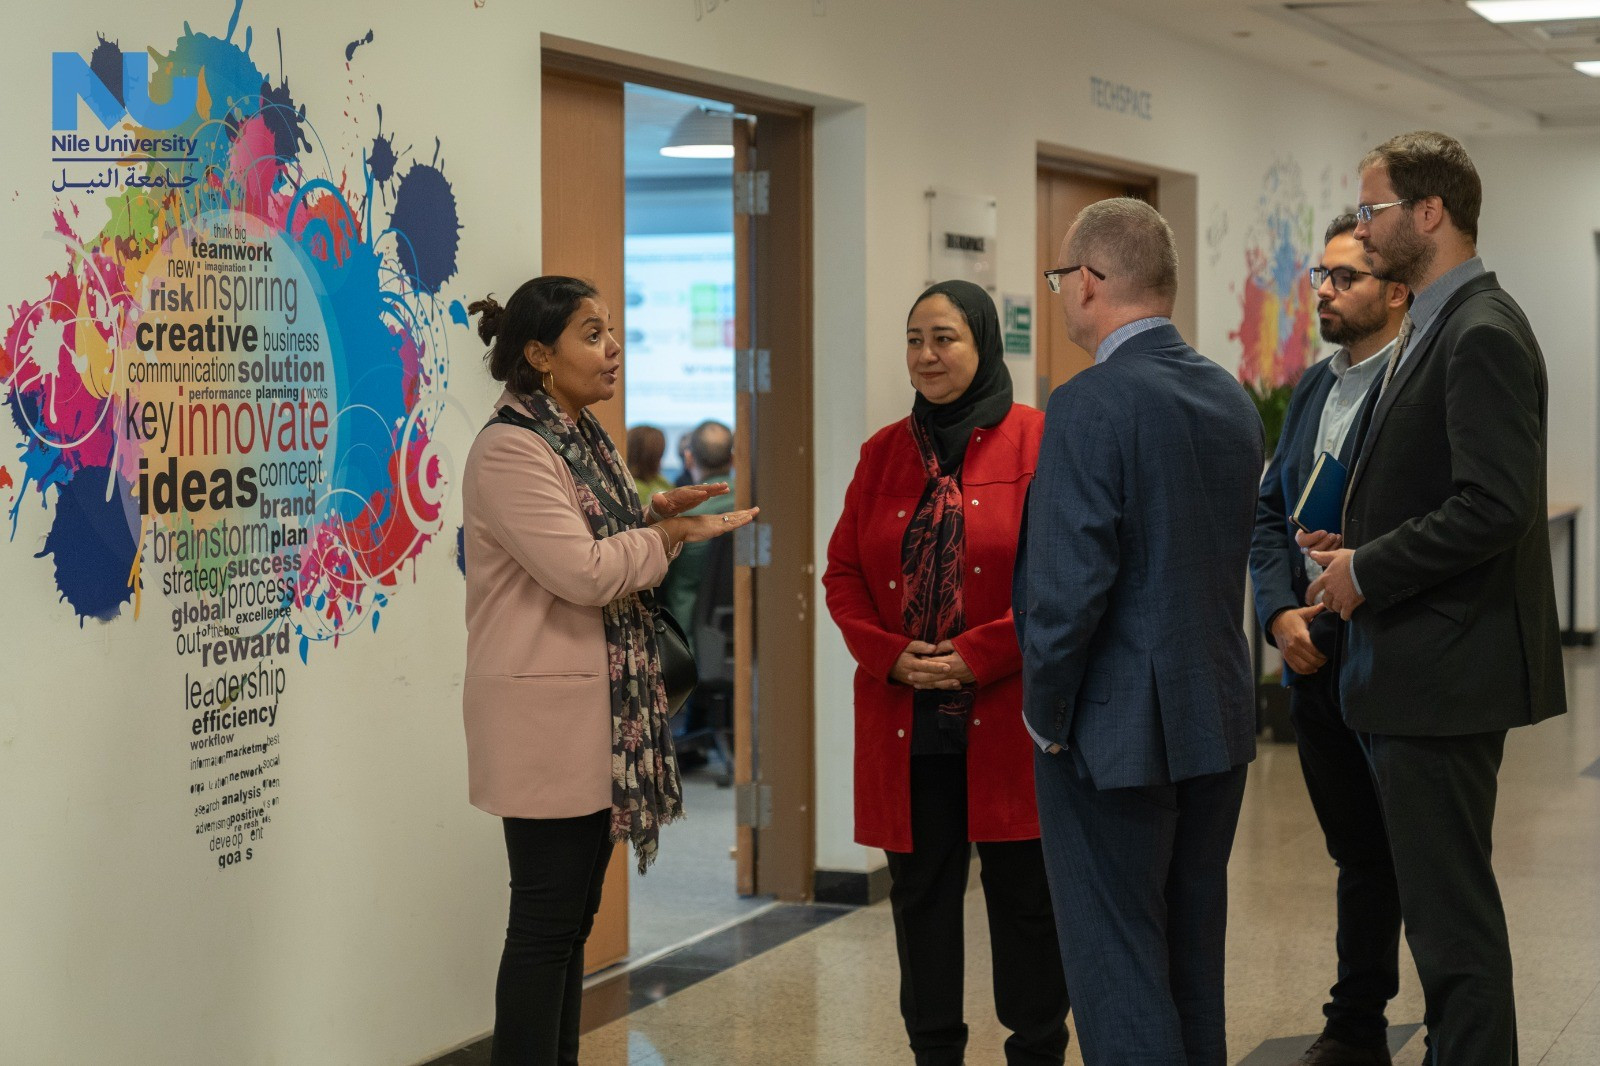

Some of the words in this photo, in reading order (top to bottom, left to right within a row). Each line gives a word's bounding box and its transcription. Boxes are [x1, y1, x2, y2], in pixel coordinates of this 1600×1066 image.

[213, 223, 232, 240] think
[234, 225, 247, 243] big
[191, 238, 273, 262] teamwork
[168, 258, 194, 278] new
[204, 261, 246, 273] imagination
[150, 282, 194, 312] risk
[197, 262, 297, 325] inspiring
[136, 315, 258, 352] creative
[263, 326, 319, 352] business
[128, 356, 235, 383] communication
[237, 354, 325, 383] solution
[188, 387, 251, 403] performance
[256, 385, 299, 402] planning
[306, 385, 328, 399] works
[126, 388, 174, 453] key
[178, 386, 329, 456] innovate
[139, 457, 258, 515] ideas
[259, 454, 323, 492] concept
[260, 489, 316, 519] brand
[153, 518, 268, 564] brainstorm
[271, 523, 308, 554] plan
[163, 564, 228, 598] strategy
[227, 553, 302, 579] success
[172, 597, 226, 632] global
[228, 576, 296, 618] process
[235, 606, 292, 624] excellence
[176, 624, 201, 656] out
[224, 625, 240, 637] box
[202, 623, 290, 668] reward
[185, 660, 286, 710] leadership
[192, 704, 278, 735] efficiency
[190, 733, 235, 751] workflow
[266, 732, 280, 747] best
[229, 764, 263, 781] network
[262, 753, 280, 769] social
[194, 798, 220, 817] esearch
[221, 786, 261, 805] analysis
[229, 806, 264, 826] positive
[209, 826, 264, 852] deveopent
[234, 818, 259, 832] reresh
[218, 847, 253, 870] goas
